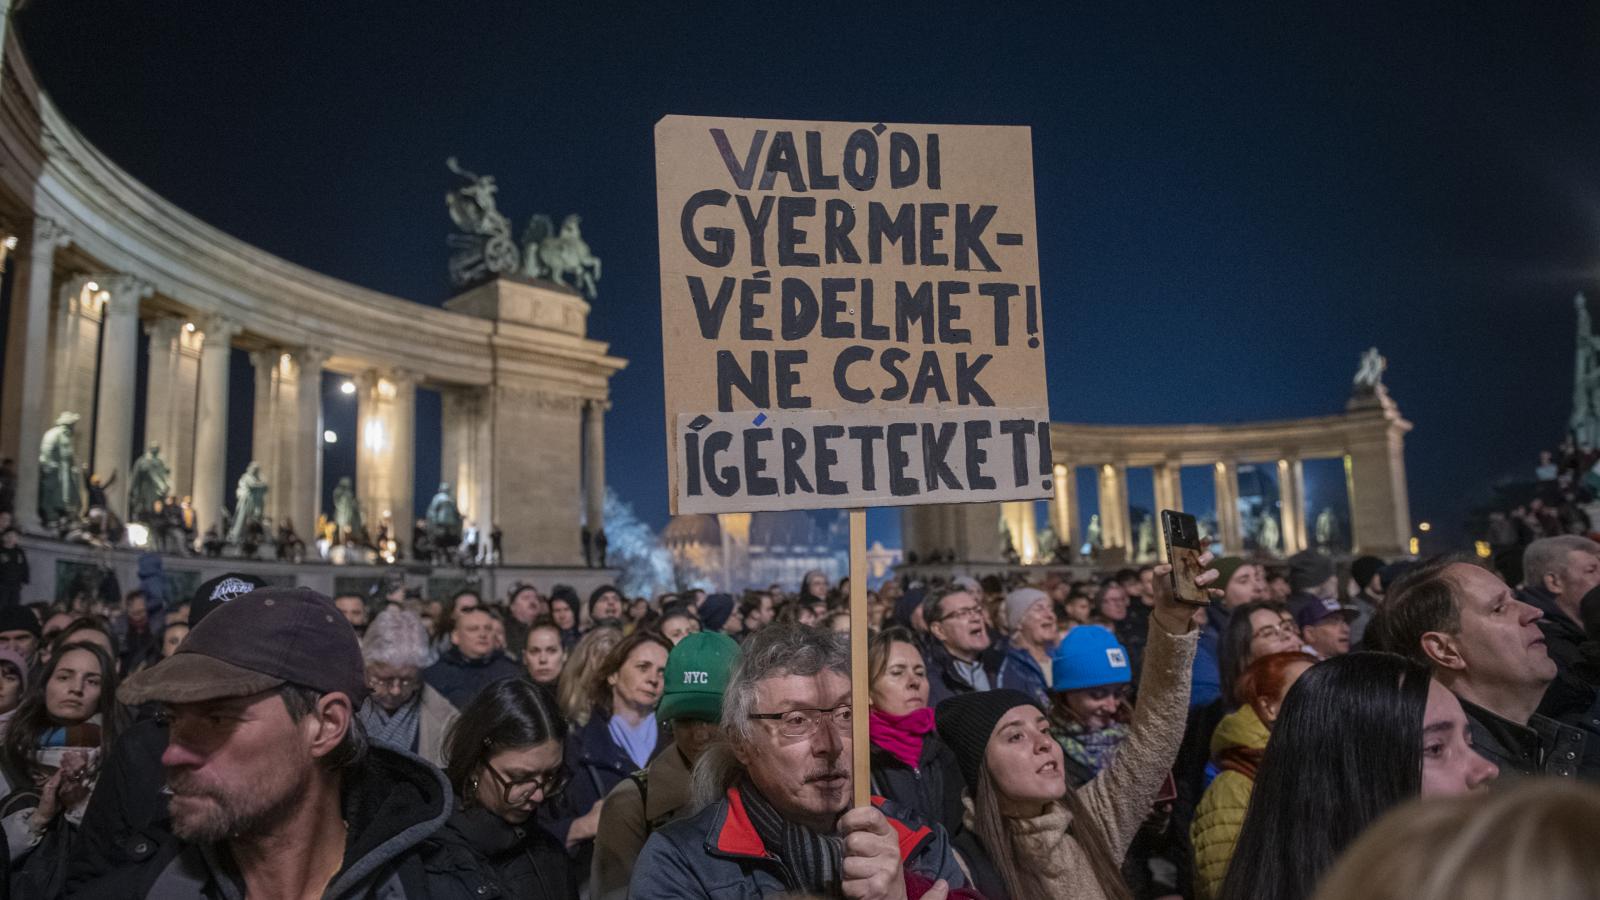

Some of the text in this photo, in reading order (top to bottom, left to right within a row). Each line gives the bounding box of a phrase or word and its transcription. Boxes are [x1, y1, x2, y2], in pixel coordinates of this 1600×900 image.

[709, 122, 941, 192] VALÓDI
[680, 189, 1023, 272] GYERMEK-
[686, 270, 1040, 349] VÉDELMET!
[717, 345, 996, 412] NE CSAK
[684, 412, 1053, 497] ÍGÉRETEKET!
[683, 671, 708, 684] NYC
